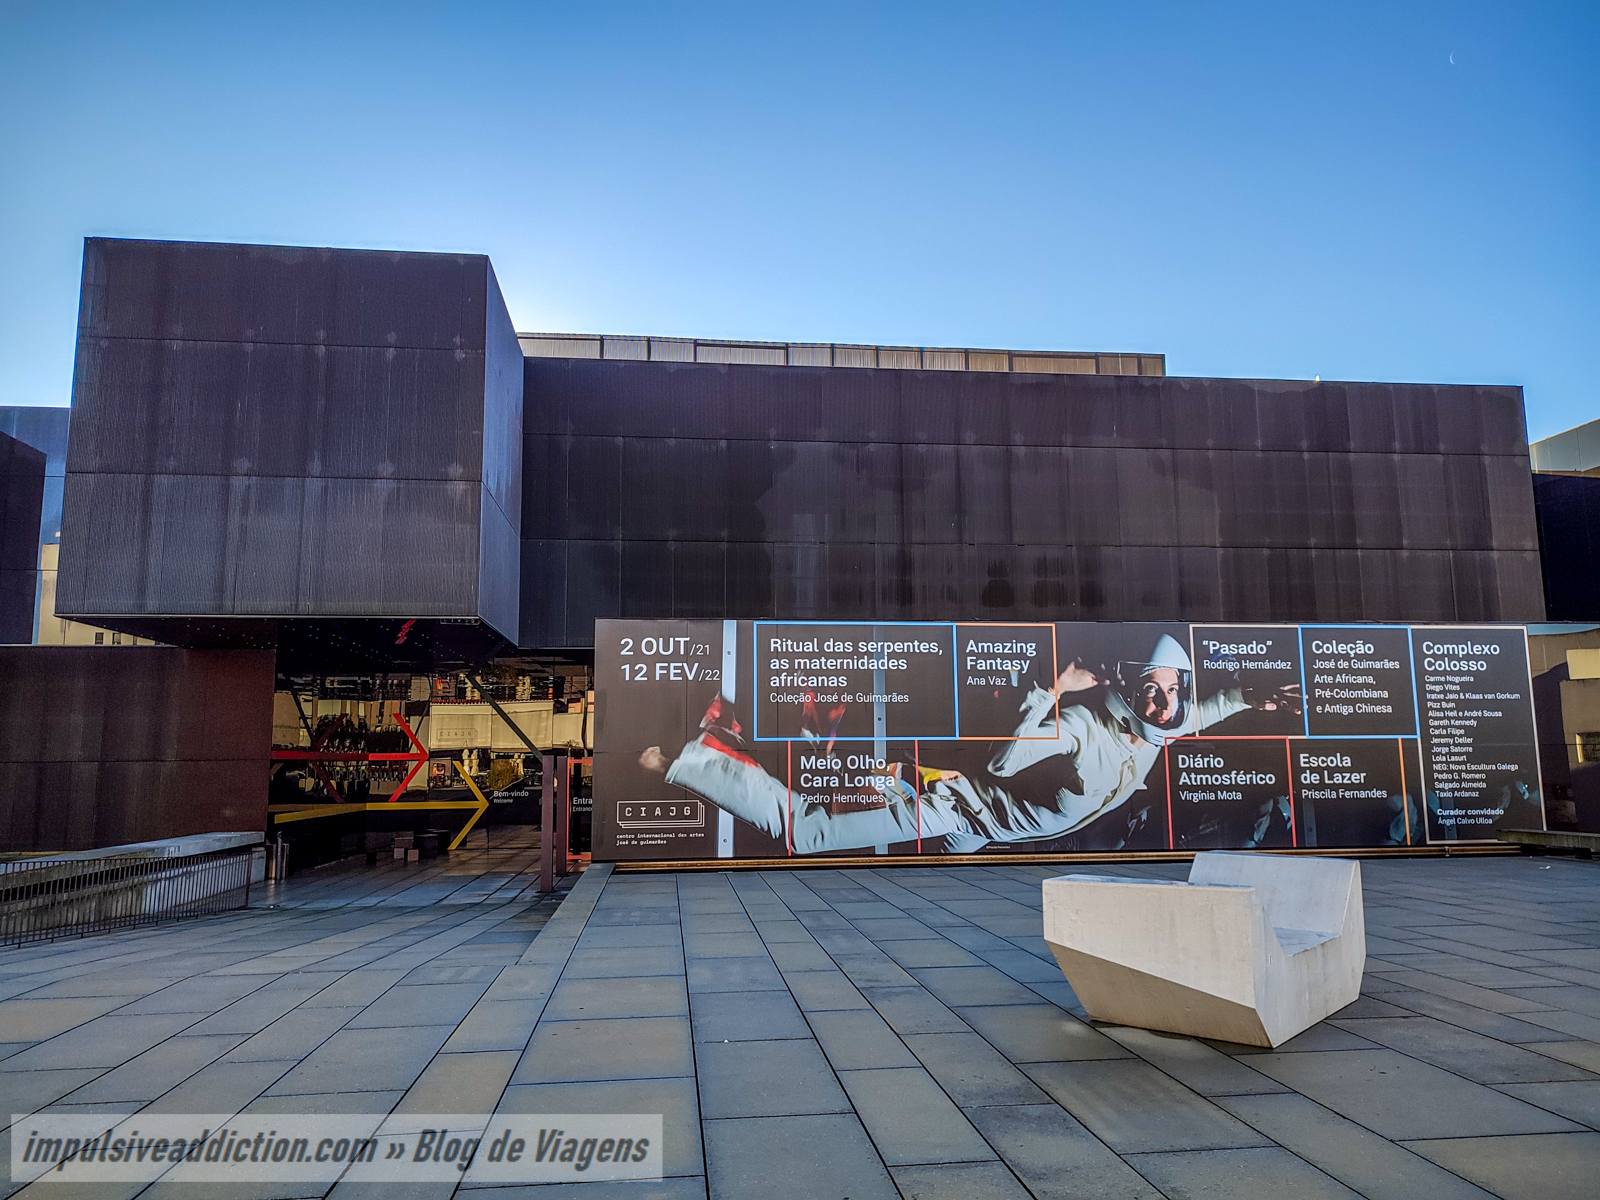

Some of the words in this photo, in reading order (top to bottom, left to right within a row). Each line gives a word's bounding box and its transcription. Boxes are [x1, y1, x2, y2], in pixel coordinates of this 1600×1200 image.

[620, 637, 634, 656] 2
[770, 638, 819, 653] Ritual
[824, 638, 854, 653] das
[858, 638, 944, 655] serpentes,
[966, 639, 1037, 657] Amazing
[1312, 640, 1375, 657] Coleção
[1422, 641, 1500, 657] Complexo
[770, 657, 790, 670] as
[794, 655, 908, 670] maternidades
[966, 656, 1030, 673] Fantasy
[1203, 659, 1240, 672] Rodrigo
[1242, 659, 1292, 670] Hernández
[1312, 659, 1335, 670] José
[1337, 659, 1350, 670] de
[1351, 659, 1400, 670] Guimarães
[1423, 657, 1487, 671] Colosso
[620, 663, 648, 681] 12
[770, 672, 848, 688] africanas
[966, 675, 986, 686] Ana
[988, 675, 1007, 686] Vaz
[1314, 674, 1334, 684] Arte
[1335, 674, 1376, 685] Africana,
[1446, 675, 1474, 683] Nogueira
[1315, 688, 1389, 699] Pré-Colombiana
[1425, 684, 1443, 692] Diego
[770, 691, 811, 705] Coleção
[813, 691, 839, 704] José
[840, 692, 854, 704] de
[855, 691, 910, 704] Guimarães
[1426, 692, 1444, 700] Iratxe
[1444, 692, 1459, 700] Jaio
[1465, 692, 1482, 700] Klaas
[1496, 692, 1521, 700] Gorkum
[1316, 705, 1322, 713] e
[1324, 704, 1354, 715] Antiga
[1355, 703, 1392, 714] Chinesa
[1427, 701, 1441, 709] Pizz
[1442, 701, 1456, 709] Buin
[1463, 709, 1482, 717] André
[1450, 719, 1478, 728] Kennedy
[1448, 728, 1465, 736] Filipe
[1430, 736, 1455, 744] Jeremy
[1454, 736, 1474, 744] Deller
[1430, 745, 1449, 753] Jorge
[1450, 745, 1473, 753] Satorre
[800, 755, 842, 770] Meio
[846, 755, 890, 772] Olho,
[1178, 754, 1224, 768] Diário
[1299, 753, 1351, 768] Escola
[1432, 754, 1446, 762] Lola
[1446, 754, 1467, 762] Lasurt
[1433, 763, 1449, 771] NEG:
[1497, 763, 1519, 771] Galega
[800, 773, 840, 788] Cara
[844, 773, 895, 790] Longa
[1178, 770, 1276, 786] Atmosférico
[1301, 771, 1320, 785] de
[1324, 770, 1366, 785] Lazer
[1434, 772, 1452, 780] Pedro
[1453, 772, 1461, 780] G.
[1461, 772, 1486, 780] Romero
[1434, 781, 1460, 790] Salgado
[1461, 781, 1487, 789] Almeida
[800, 793, 830, 804] Pedro
[833, 793, 884, 805] Henriques
[1179, 789, 1215, 802] Virgínia
[1218, 790, 1243, 800] Mota
[1301, 789, 1337, 799] Priscila
[1338, 788, 1388, 799] Fernandes
[1434, 790, 1453, 798] Taxio
[1453, 790, 1480, 798] Ardanaz
[573, 797, 593, 805] Entra
[1437, 808, 1466, 816] Curador
[1467, 808, 1504, 816] convidado
[1437, 816, 1456, 826] Ángel
[1456, 817, 1475, 825] Calvo
[1475, 817, 1493, 825] Ulloa
